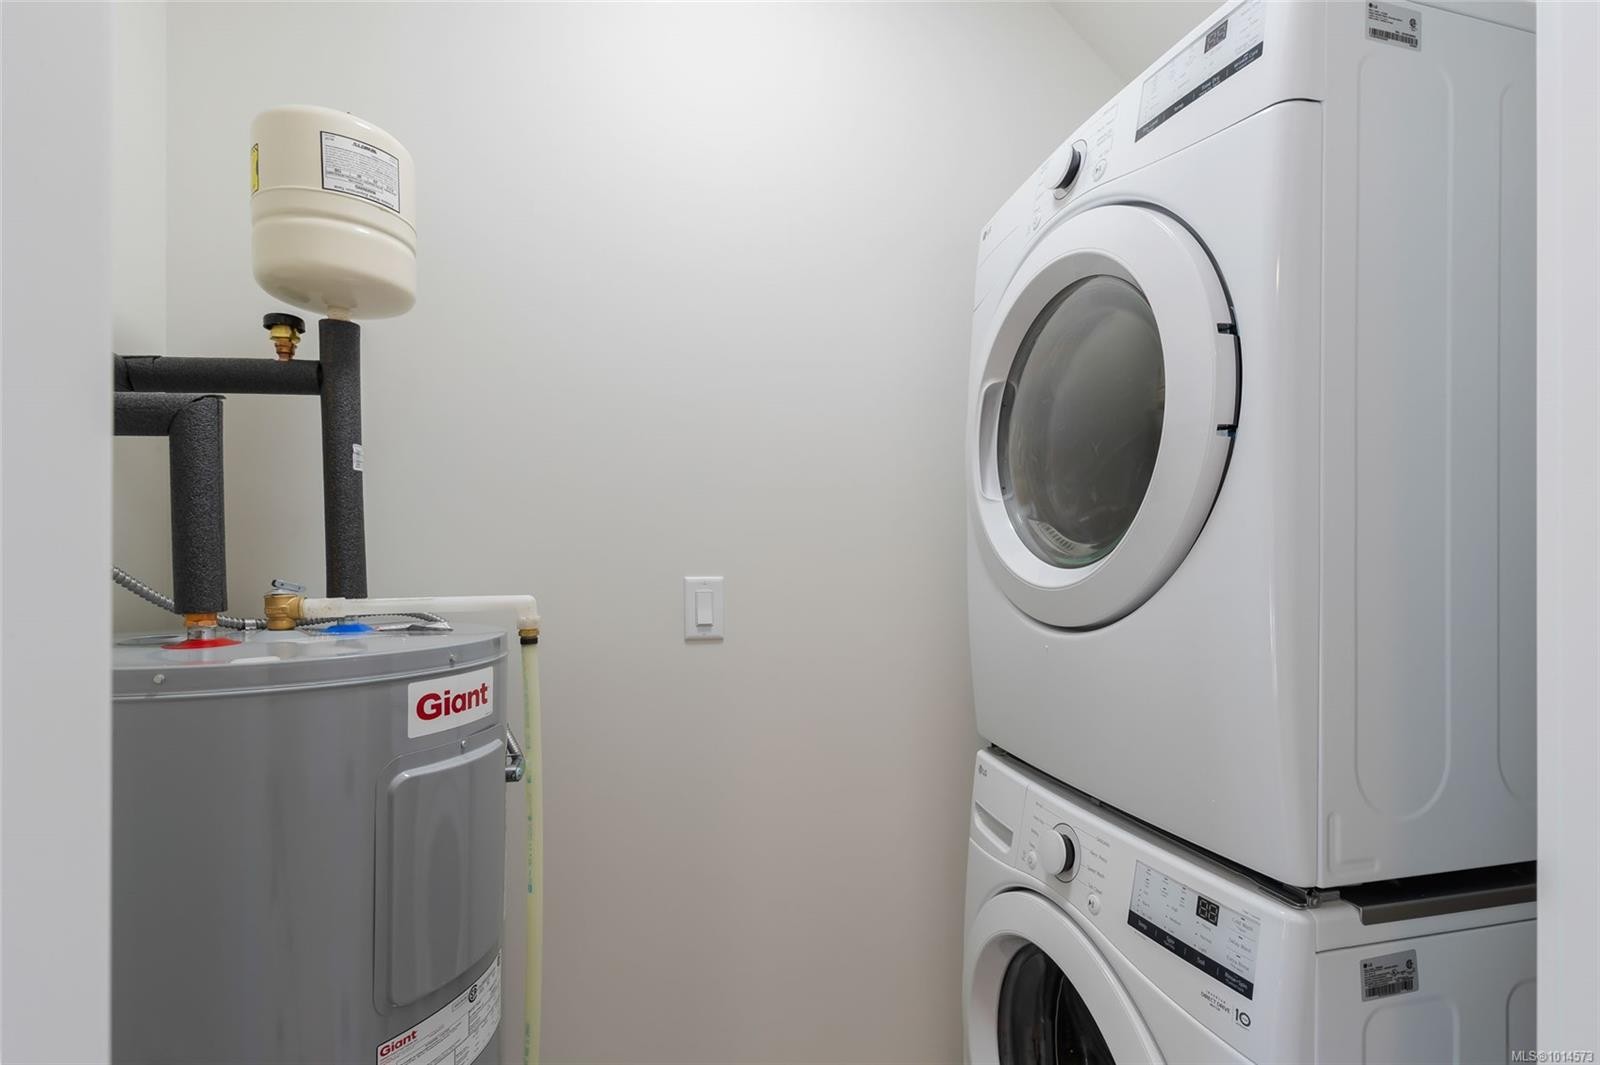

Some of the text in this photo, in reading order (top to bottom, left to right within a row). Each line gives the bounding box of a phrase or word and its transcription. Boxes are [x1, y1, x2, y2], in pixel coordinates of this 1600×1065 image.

[416, 683, 488, 721] Giant
[1235, 1008, 1252, 1028] 10
[380, 1031, 418, 1057] Giant
